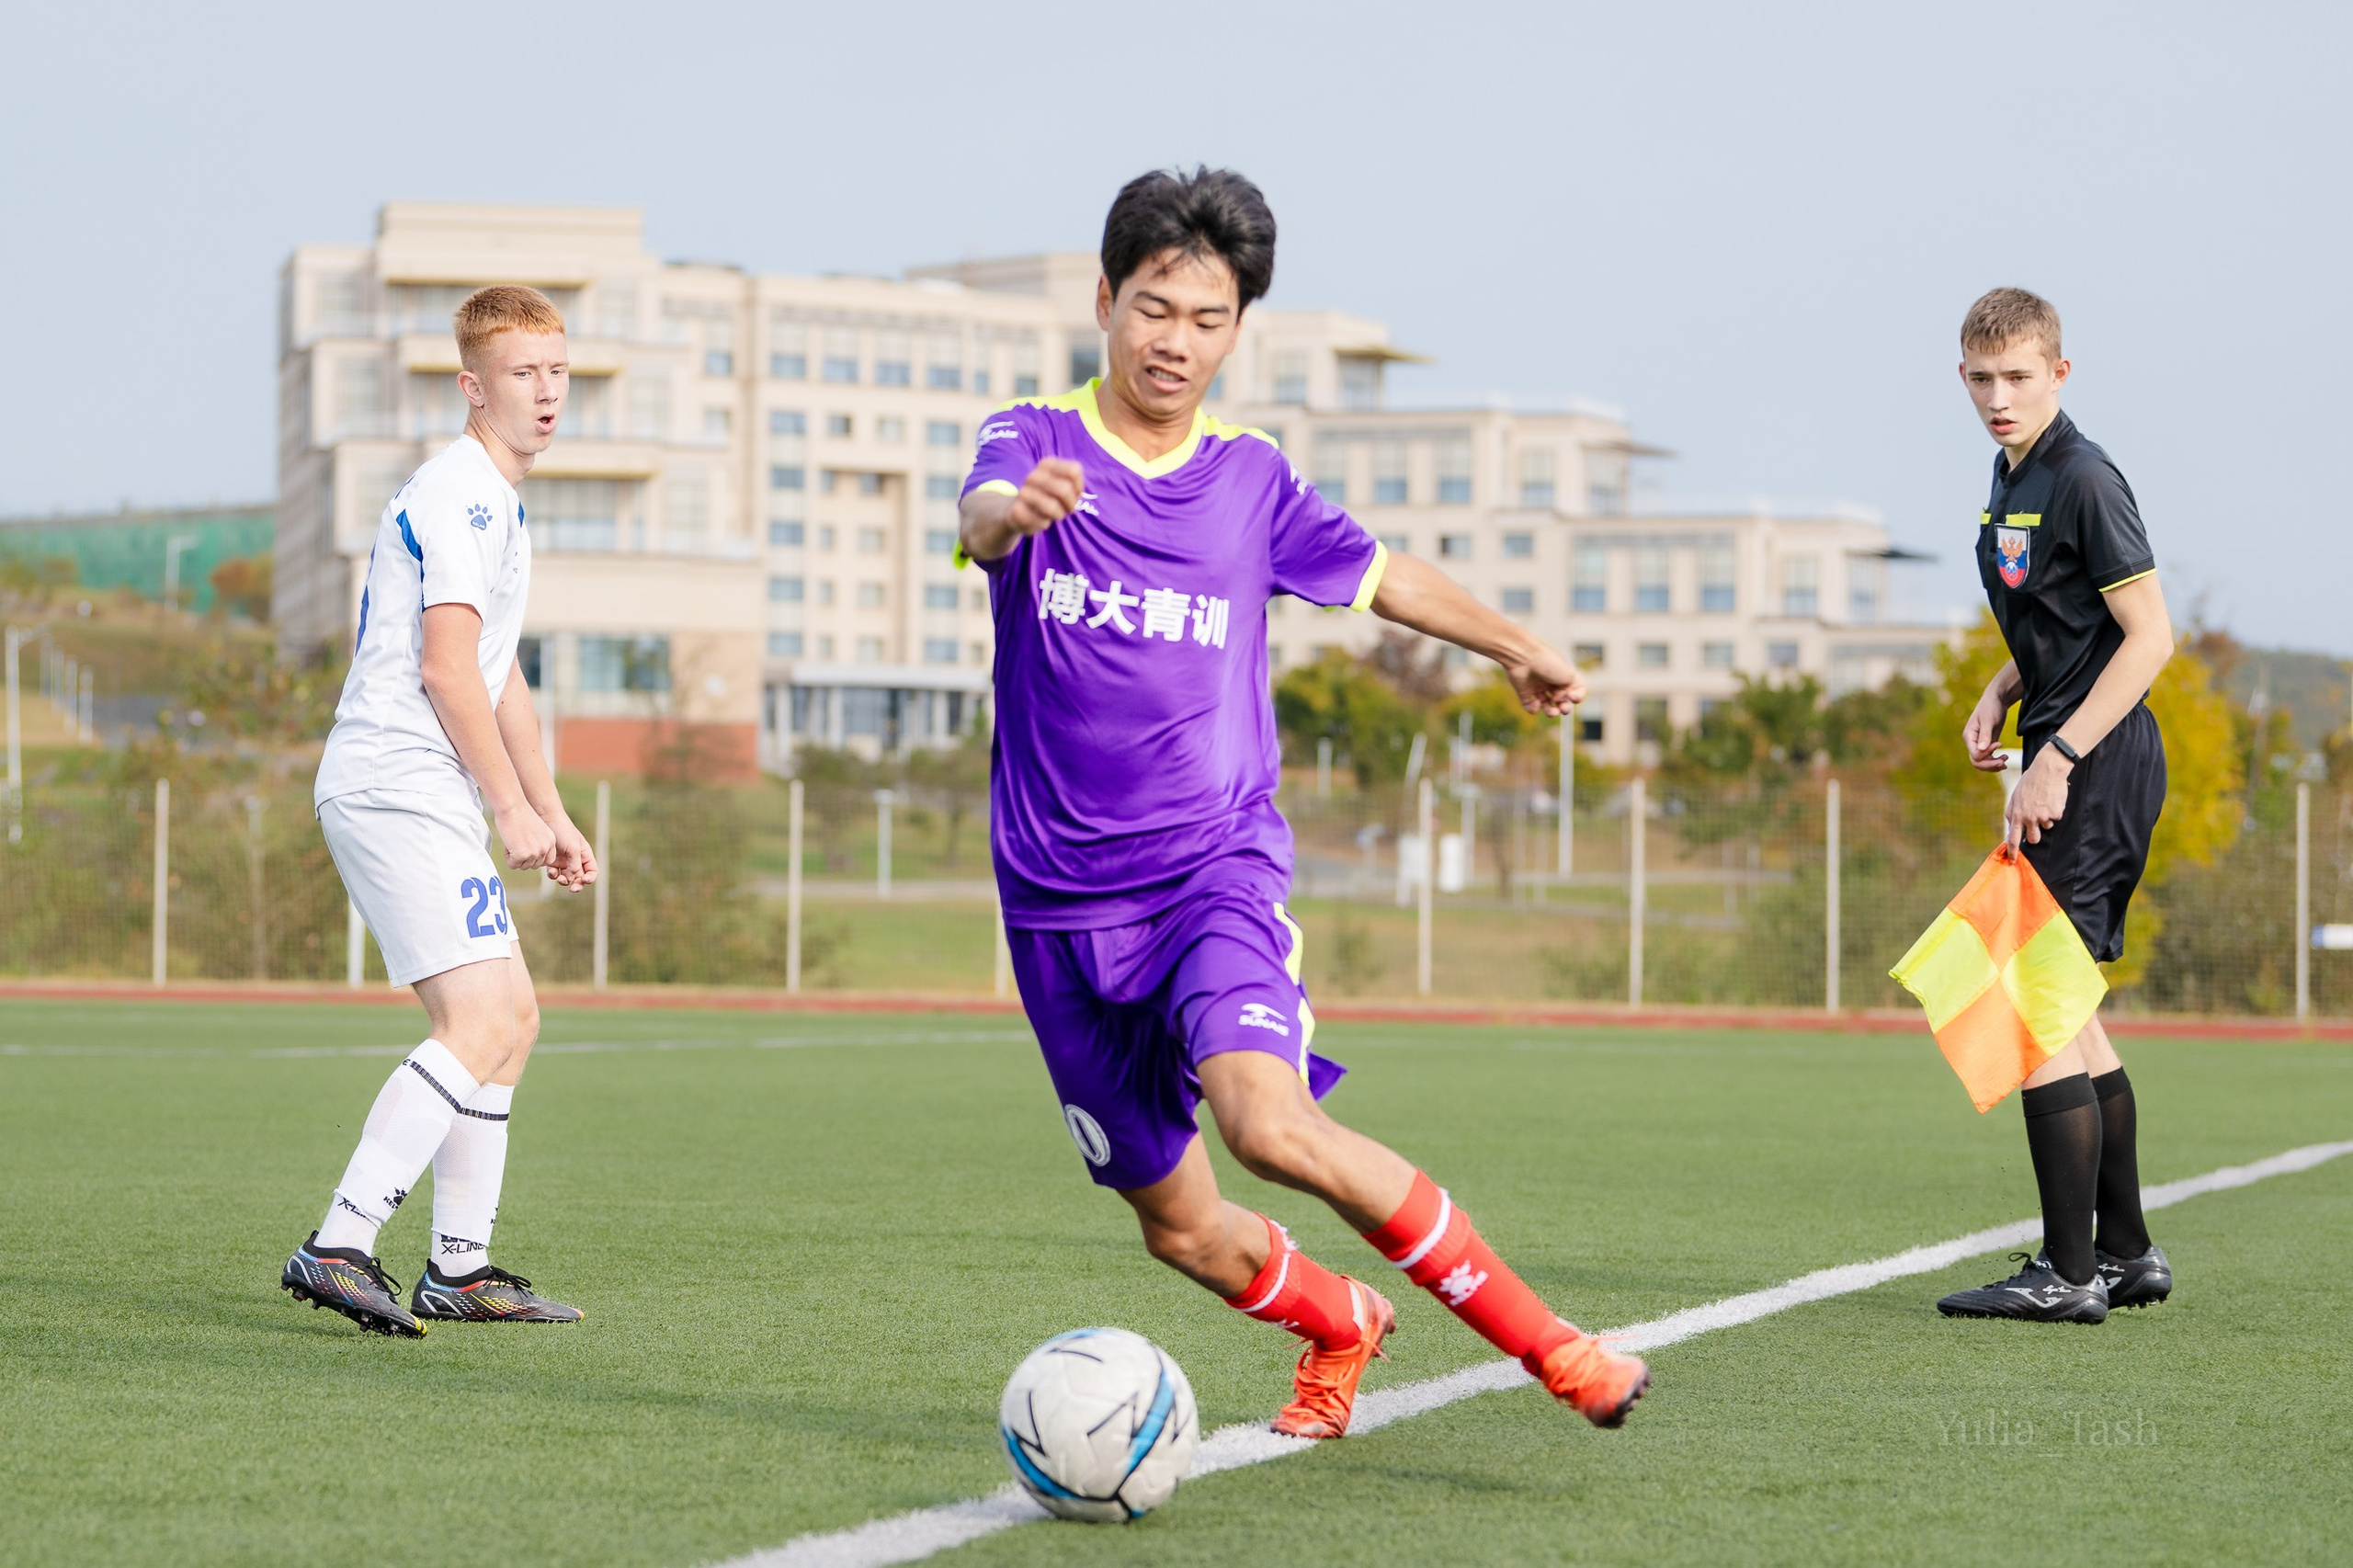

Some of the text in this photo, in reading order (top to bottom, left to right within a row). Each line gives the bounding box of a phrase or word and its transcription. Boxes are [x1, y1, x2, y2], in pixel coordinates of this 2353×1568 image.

[1038, 567, 1231, 650] 博大青训
[460, 875, 508, 938] 23
